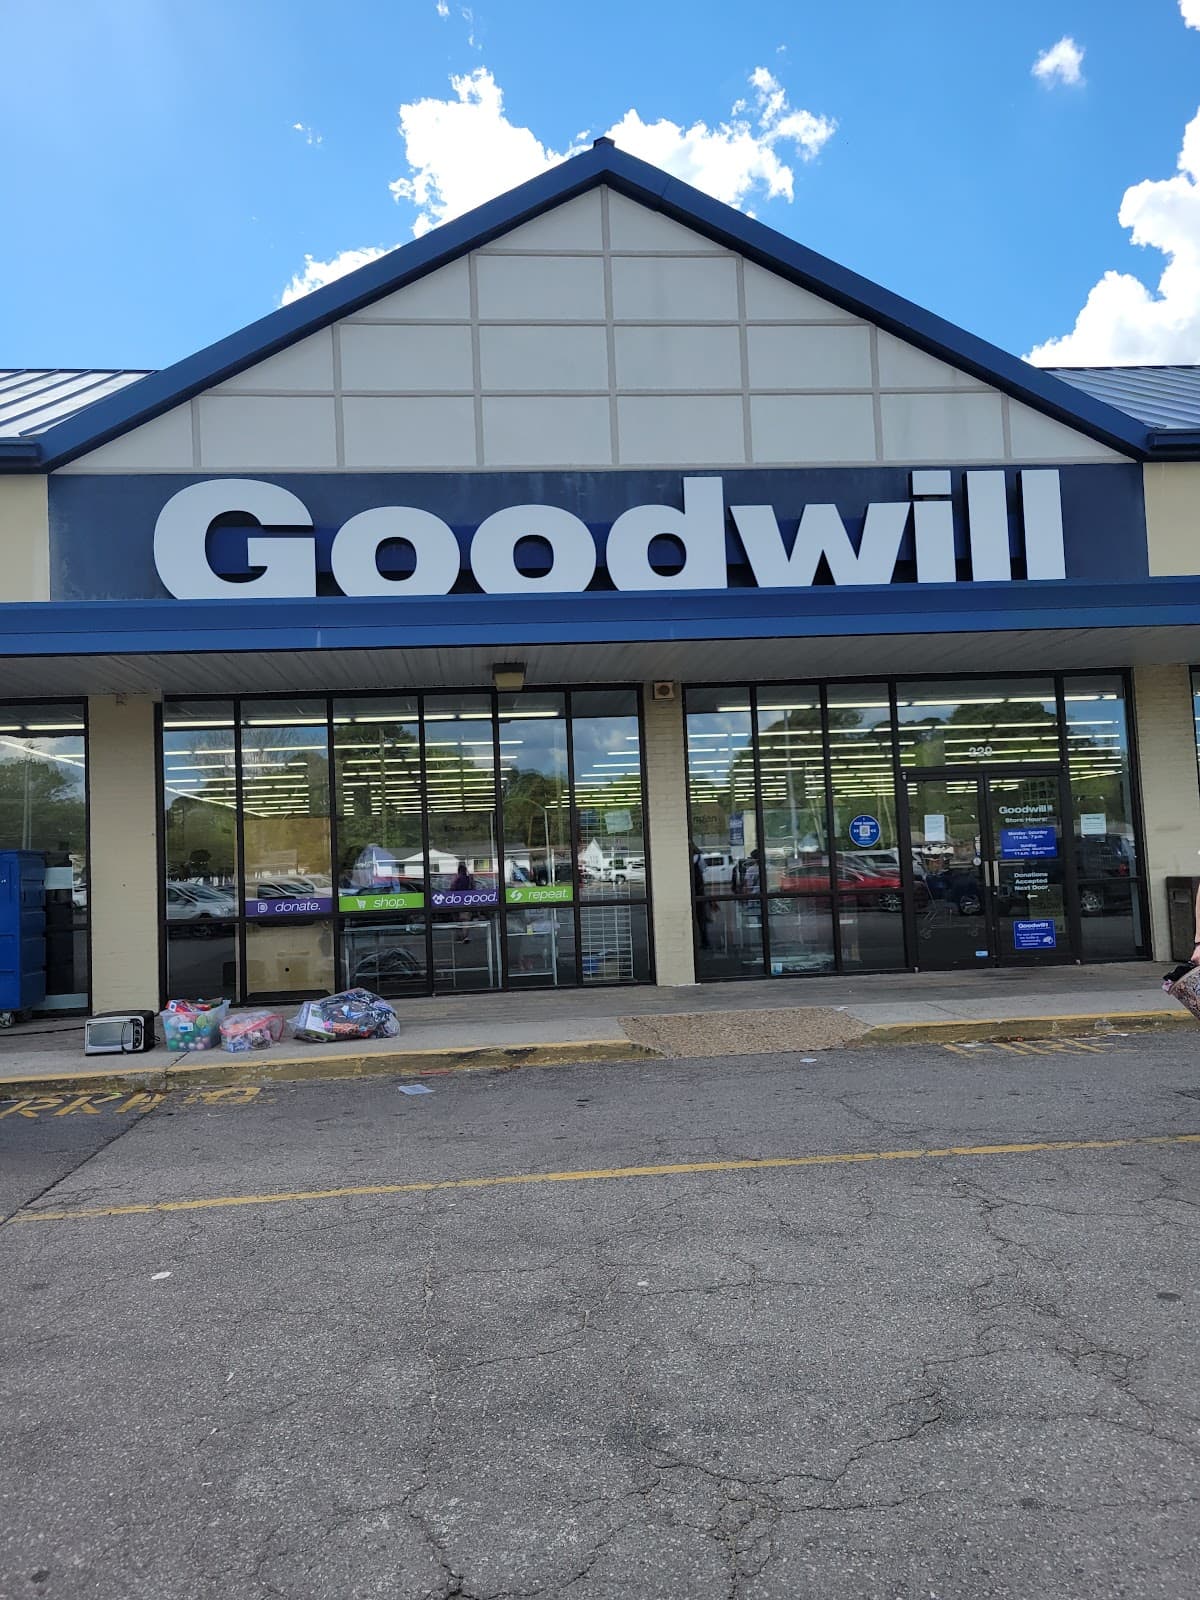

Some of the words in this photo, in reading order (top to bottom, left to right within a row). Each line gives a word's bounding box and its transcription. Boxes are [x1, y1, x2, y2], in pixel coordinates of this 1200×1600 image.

[154, 469, 1066, 600] Goodwill
[999, 804, 1048, 815] Goodwill
[445, 894, 461, 904] do
[464, 892, 498, 905] good.
[528, 889, 569, 900] repeat.
[275, 901, 321, 913] donate.
[373, 897, 407, 910] shop.
